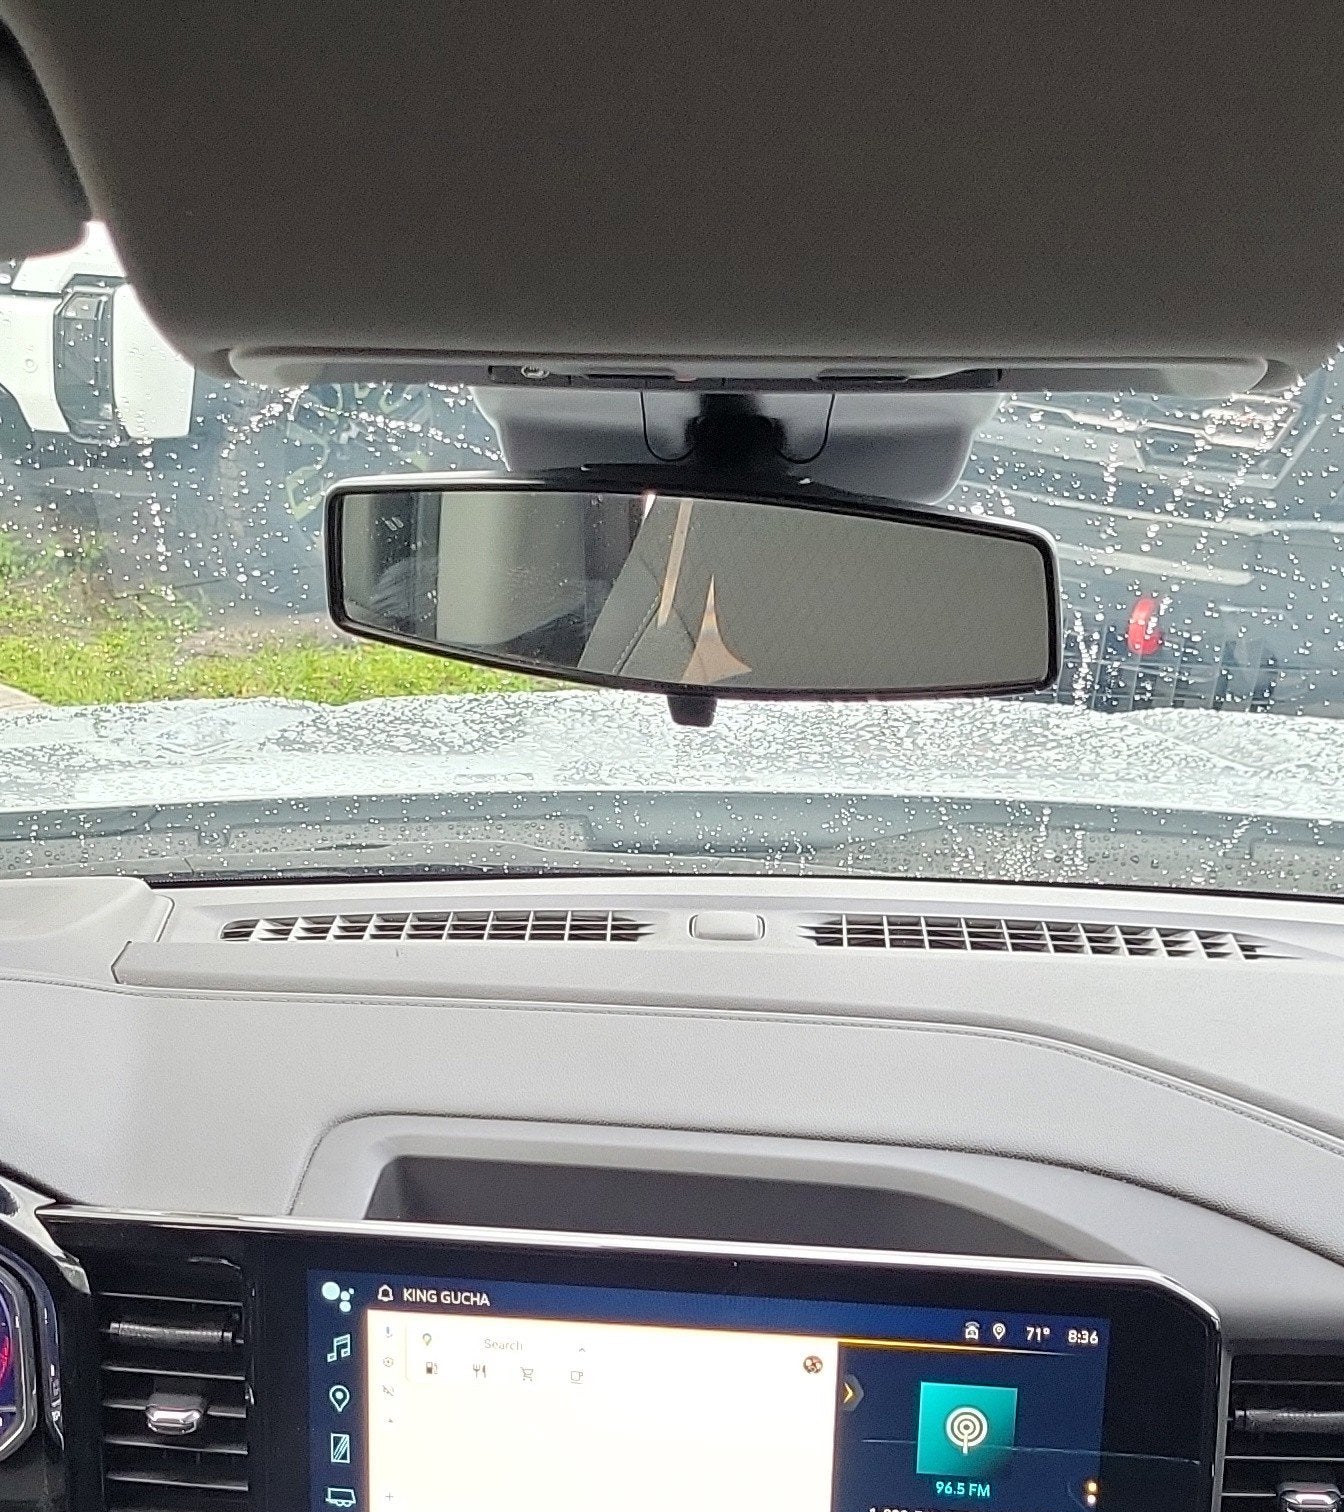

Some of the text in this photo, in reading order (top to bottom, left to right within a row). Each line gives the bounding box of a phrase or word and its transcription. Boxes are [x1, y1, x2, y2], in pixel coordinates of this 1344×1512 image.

[403, 1287, 491, 1308] KING GUCHA
[1026, 1326, 1051, 1342] 71°
[1068, 1329, 1099, 1345] 8:36
[484, 1338, 524, 1352] Search
[935, 1480, 991, 1498] 96.5 FM
